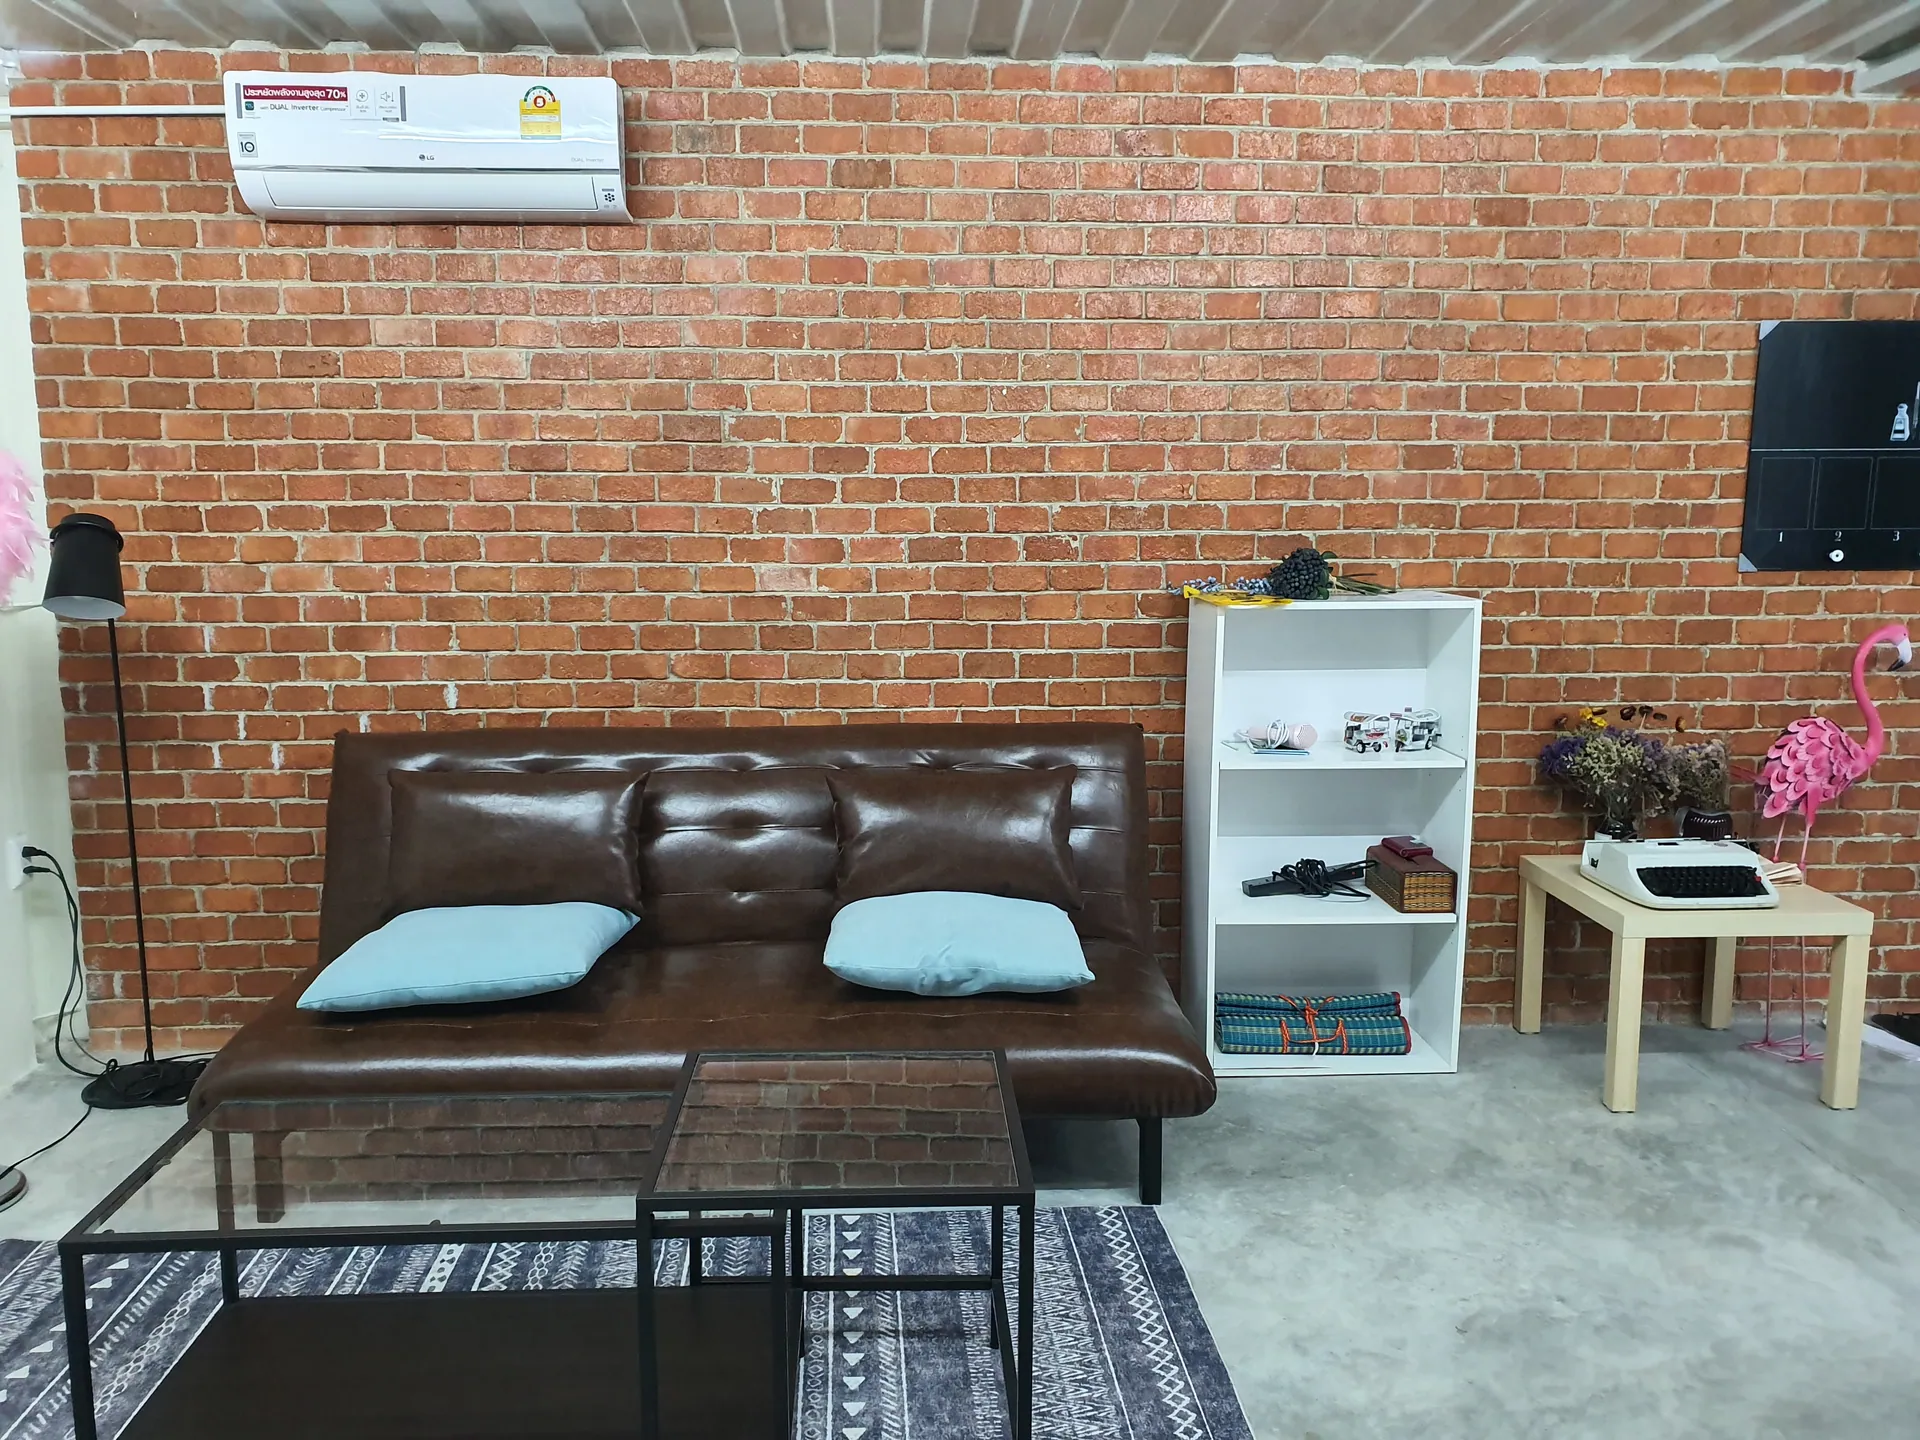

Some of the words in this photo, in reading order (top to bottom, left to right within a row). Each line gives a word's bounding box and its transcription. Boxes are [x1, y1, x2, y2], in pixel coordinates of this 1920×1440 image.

[326, 88, 347, 99] 70%
[240, 141, 255, 153] 10
[1779, 531, 1784, 543] 1
[1834, 530, 1842, 542] 2
[1892, 530, 1900, 542] 3
